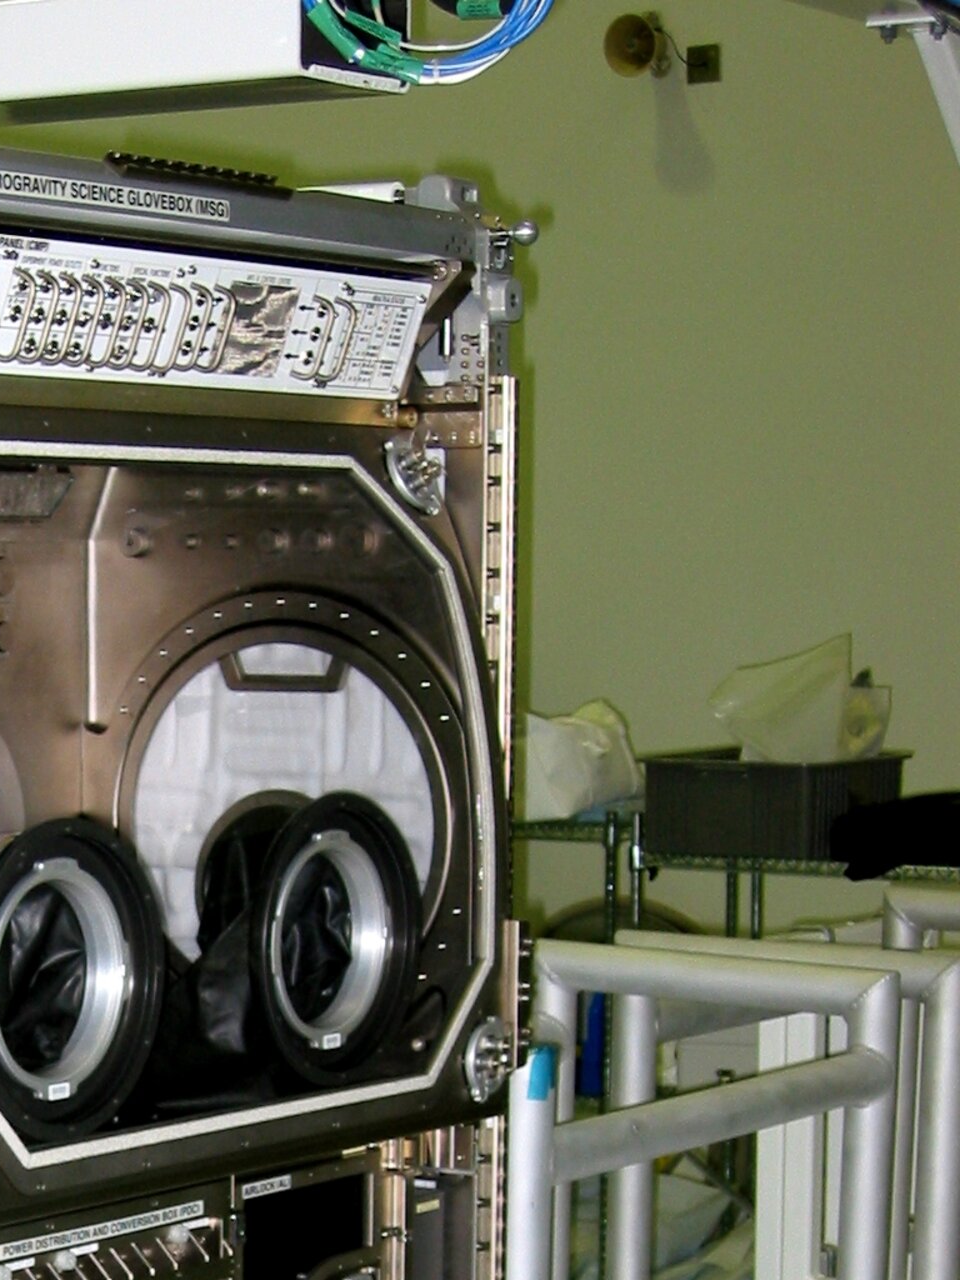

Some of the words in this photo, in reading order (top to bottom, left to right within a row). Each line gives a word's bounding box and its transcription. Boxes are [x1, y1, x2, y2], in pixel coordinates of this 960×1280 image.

[70, 182, 124, 204] SCIENCE
[127, 189, 194, 213] GLOVEBOX
[195, 199, 230, 219] (MSG)
[0, 236, 25, 250] PANEL
[244, 1181, 275, 1197] AIRLOCK
[3, 1240, 33, 1256] POWER
[35, 1227, 91, 1250] DISTRIBUTION
[92, 1223, 109, 1237] AND
[110, 1212, 161, 1234] CONVERSION
[161, 1209, 179, 1222] BOX
